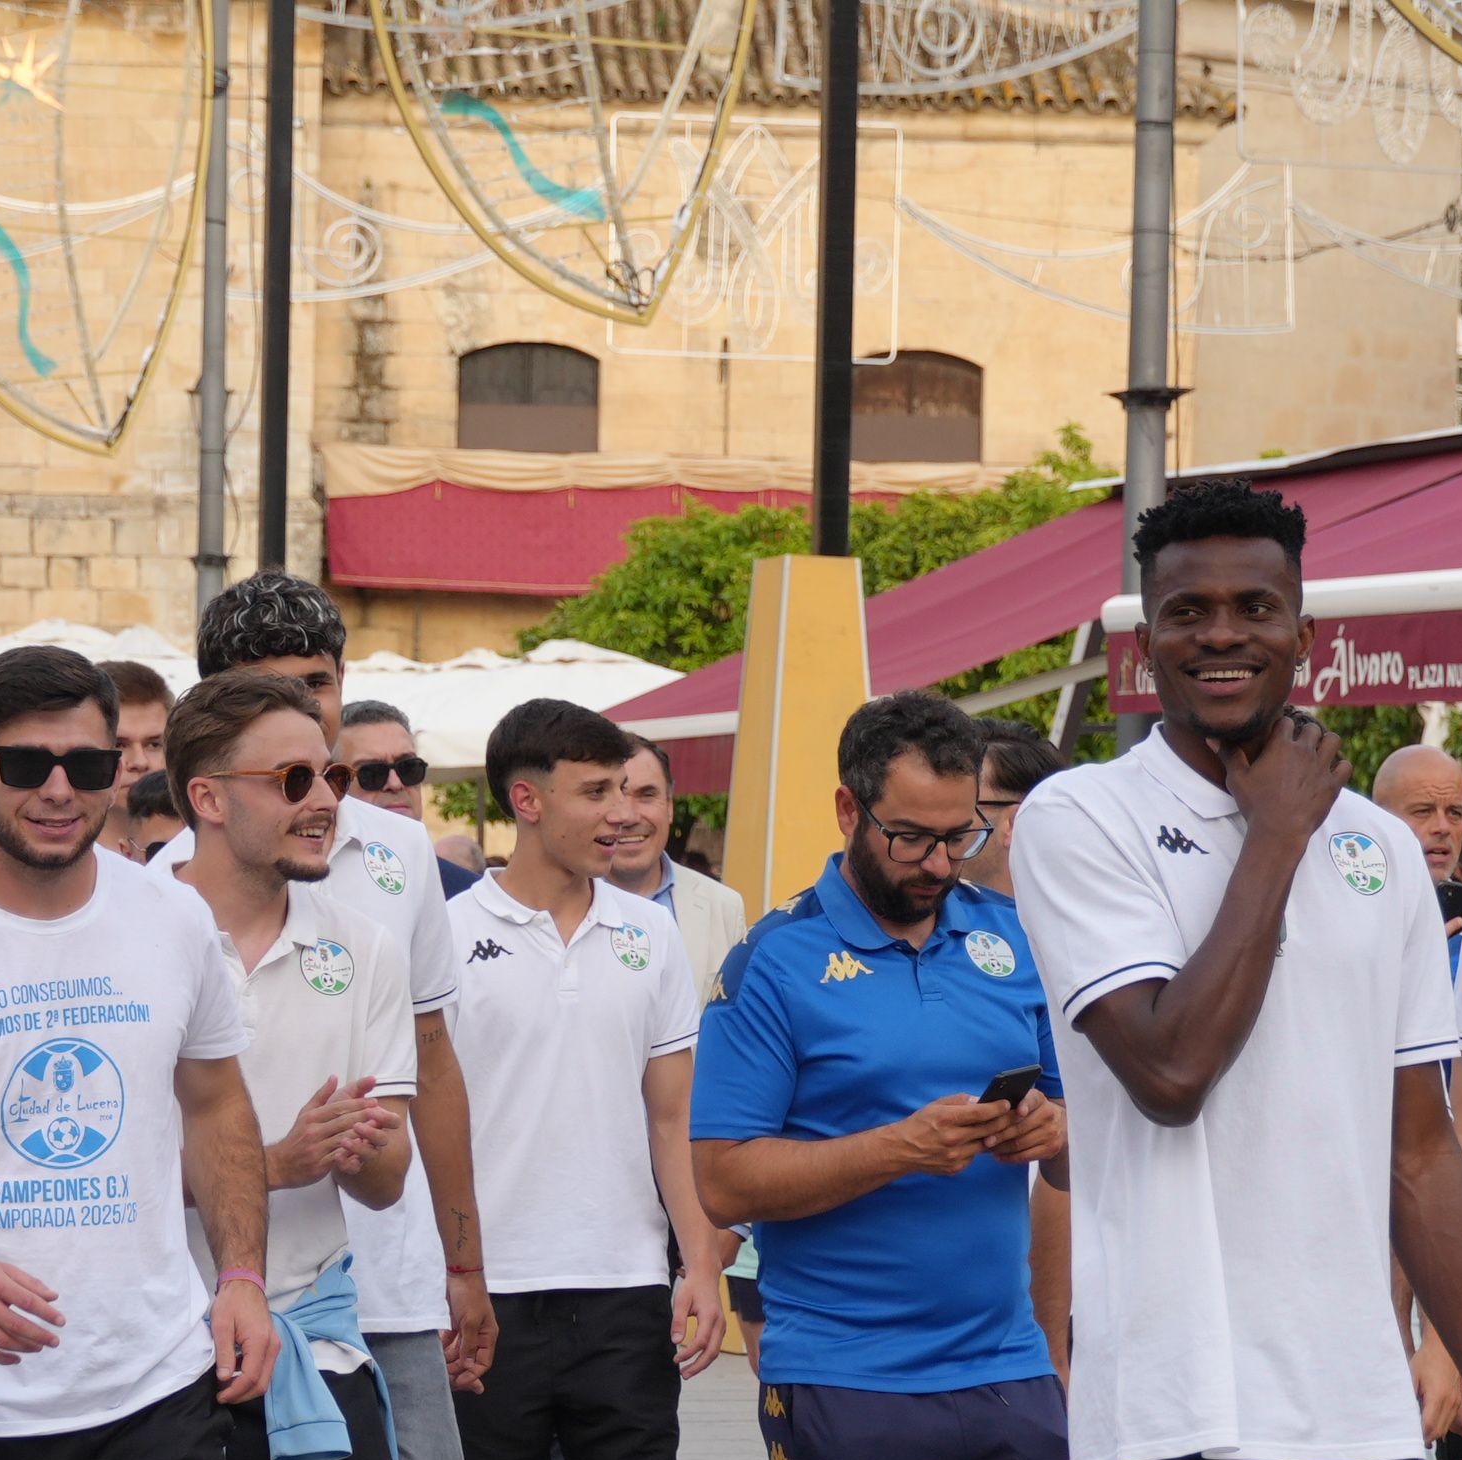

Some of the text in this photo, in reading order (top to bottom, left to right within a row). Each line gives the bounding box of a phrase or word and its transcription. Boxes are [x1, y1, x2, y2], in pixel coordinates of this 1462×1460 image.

[1312, 624, 1404, 702] Álvaro
[1407, 664, 1444, 690] PLAZA
[10, 976, 124, 1005] CONSEGUIMOS...
[24, 1010, 43, 1031] DE
[62, 1001, 151, 1027] FEDERACIÓN!
[56, 1097, 71, 1112] de
[77, 1094, 120, 1111] Lucena
[106, 1174, 130, 1200] G.X
